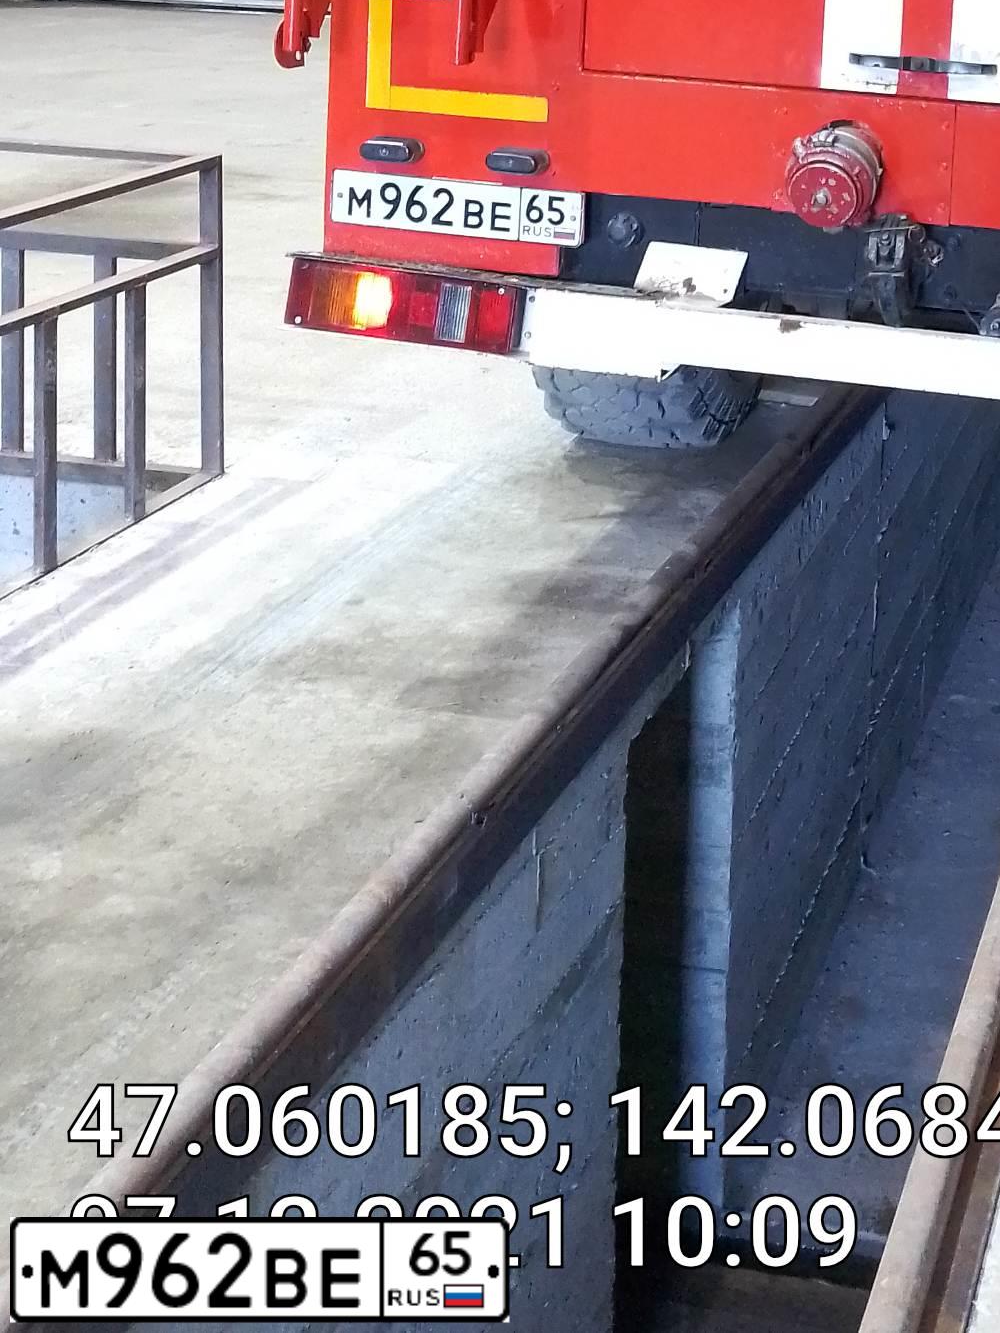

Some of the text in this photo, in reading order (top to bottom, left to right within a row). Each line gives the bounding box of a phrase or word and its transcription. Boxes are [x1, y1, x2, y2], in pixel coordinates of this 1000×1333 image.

[347, 182, 565, 232] М962ВЕ 65
[522, 225, 552, 238] RUS
